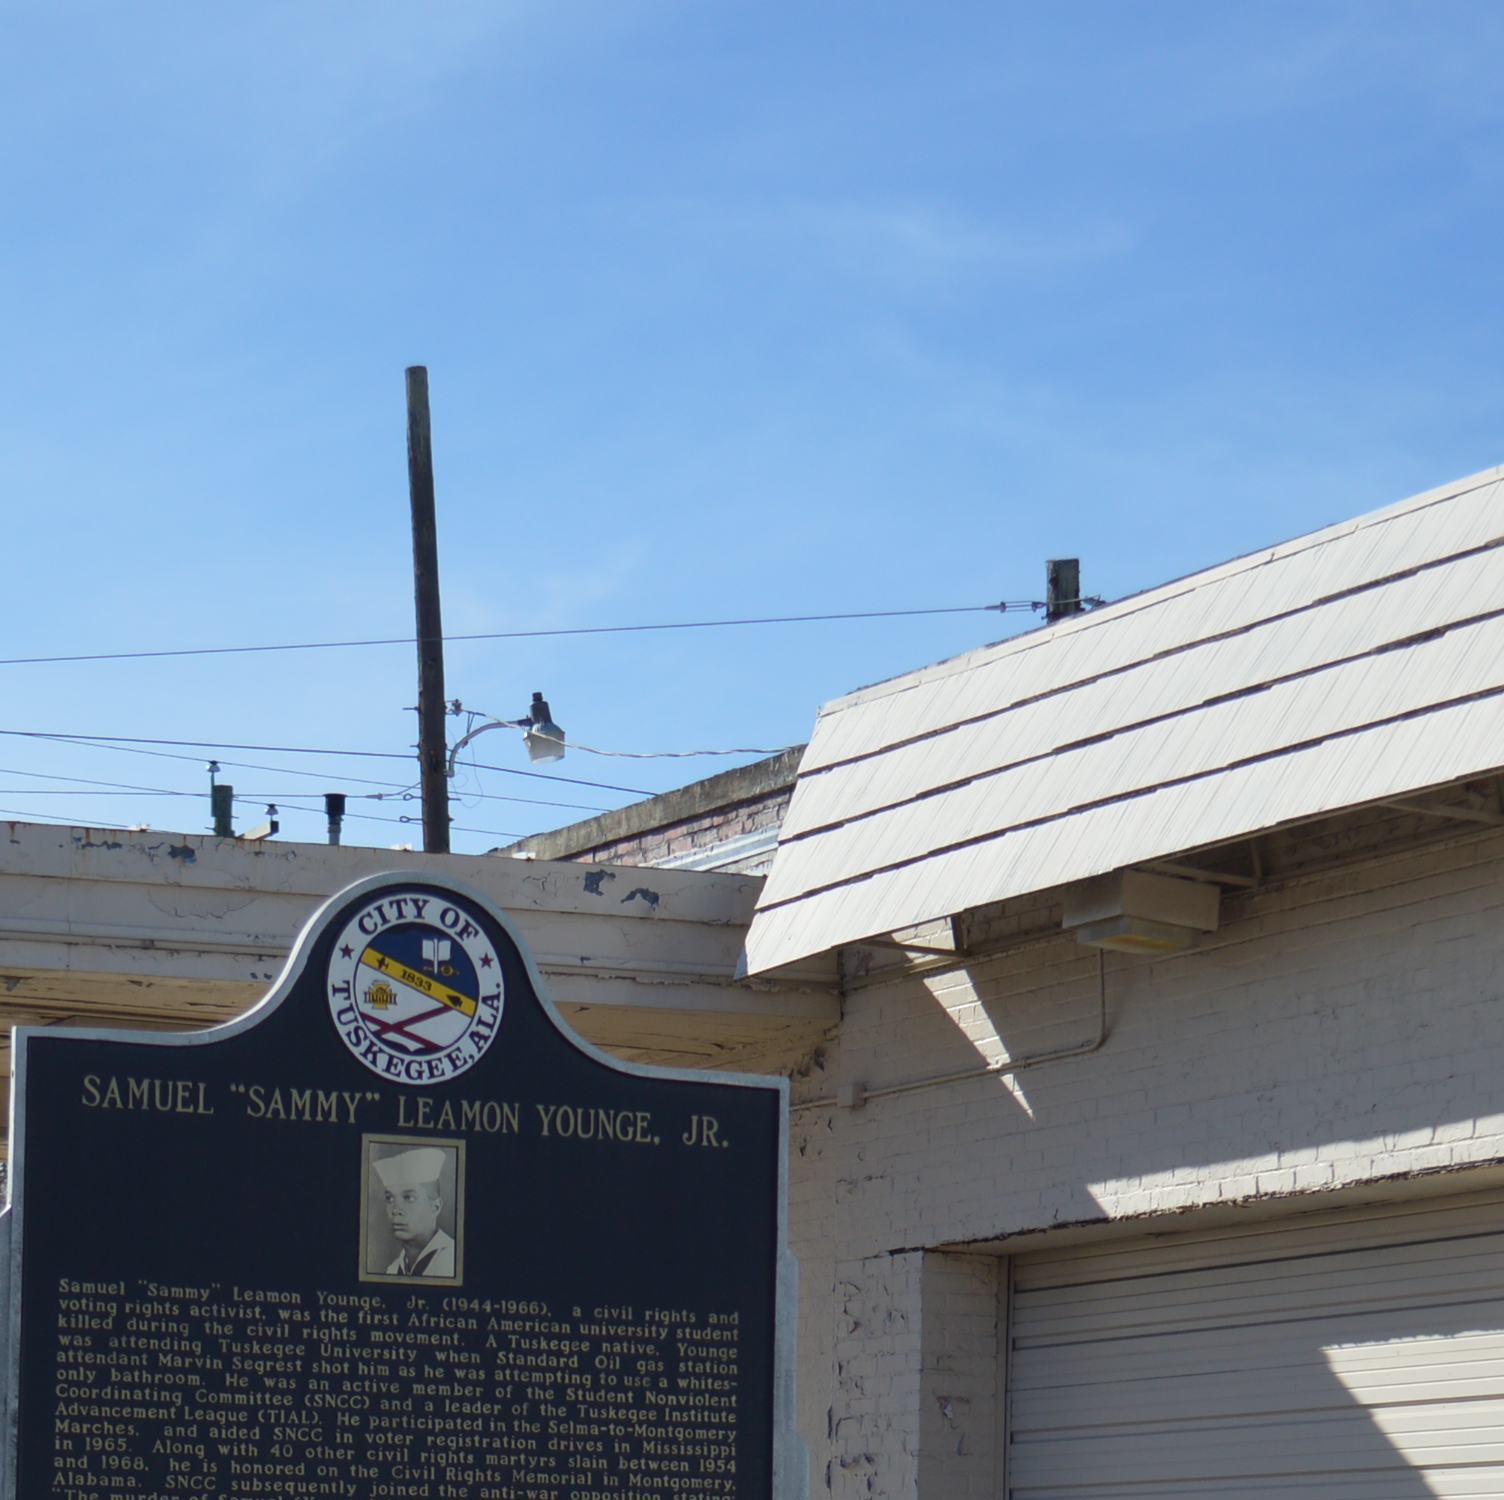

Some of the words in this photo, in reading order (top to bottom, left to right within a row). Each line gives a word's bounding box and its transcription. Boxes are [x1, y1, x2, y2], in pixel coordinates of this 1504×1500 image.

[358, 897, 430, 936] CITY
[439, 907, 480, 942] OF
[401, 969, 432, 992] 1833
[332, 980, 476, 1081] TUSKEGEE,
[468, 982, 501, 1053] ALA.
[82, 1075, 214, 1114] SAMUEL
[230, 1084, 380, 1124] "SAMMY"
[397, 1096, 519, 1134] LEAMON
[536, 1105, 660, 1145] YOUNGE,
[682, 1115, 729, 1148] JR.
[58, 1278, 125, 1295] Samuel
[138, 1279, 220, 1302] "Sammy"
[233, 1286, 301, 1304] Leamon
[317, 1290, 385, 1310] Younge,
[406, 1295, 429, 1309] Jr.
[442, 1297, 551, 1317] (1944-1966),
[572, 1306, 581, 1317] a
[593, 1305, 632, 1320] civil
[645, 1307, 696, 1324] rights
[708, 1311, 738, 1325] and
[58, 1297, 117, 1316] voting
[125, 1299, 179, 1318] rights
[190, 1303, 266, 1320] activist,
[277, 1309, 310, 1321] was
[319, 1308, 348, 1323] the
[358, 1309, 398, 1325] first
[407, 1312, 477, 1329] African
[487, 1316, 570, 1334] American
[579, 1321, 668, 1340] university
[676, 1326, 738, 1341] student
[58, 1313, 113, 1329] killed
[126, 1316, 189, 1337] during
[204, 1321, 233, 1335] the
[246, 1322, 289, 1338] civil
[302, 1325, 356, 1343] rights
[370, 1330, 464, 1346] movement.
[485, 1333, 497, 1348] A
[507, 1334, 590, 1353] Tuskegee
[601, 1340, 659, 1356] native,
[677, 1342, 737, 1360] Younge
[58, 1334, 91, 1346] was
[108, 1335, 201, 1354] attending
[218, 1338, 305, 1358] Tuskegee
[320, 1341, 417, 1362] University
[434, 1349, 480, 1363] when
[496, 1350, 578, 1368] Standard
[594, 1354, 620, 1370] Oil
[636, 1360, 664, 1373] gas
[678, 1358, 737, 1375] station
[55, 1383, 182, 1406] Coordinating
[195, 1388, 293, 1406] Committee
[304, 1393, 370, 1409] (SNCC)
[380, 1397, 412, 1411] and
[424, 1401, 433, 1412] a
[445, 1398, 502, 1415] leader
[511, 1402, 529, 1415] of
[539, 1403, 567, 1417] the
[576, 1404, 657, 1423] Tuskegee
[664, 1407, 736, 1423] Institute
[56, 1366, 96, 1383] only
[111, 1367, 205, 1386] bathroom.
[225, 1372, 248, 1387] He
[263, 1377, 296, 1389] was
[308, 1378, 329, 1391] an
[342, 1378, 399, 1393] active
[412, 1382, 483, 1397] member
[495, 1384, 513, 1398] of
[526, 1384, 554, 1400] the
[566, 1386, 633, 1403] Student
[645, 1390, 737, 1407] Nonviolent
[55, 1401, 176, 1419] Advancement
[184, 1405, 248, 1424] League
[257, 1409, 322, 1425] (TIAL).
[337, 1411, 360, 1426] He
[369, 1414, 482, 1432] participated
[489, 1417, 506, 1432] in
[513, 1419, 540, 1433] the
[548, 1419, 736, 1443] Selma-to-Montgomery
[55, 1418, 139, 1436] Marches,
[164, 1424, 197, 1437] and
[209, 1423, 260, 1440] aided
[273, 1426, 322, 1442] SNCC
[335, 1428, 353, 1444] in
[364, 1431, 413, 1445] voter
[426, 1431, 536, 1450] registration
[548, 1436, 603, 1452] drives
[614, 1438, 630, 1453] in
[642, 1440, 736, 1459] Mississippi
[53, 1471, 141, 1487] Alabama.
[165, 1474, 216, 1490] SNCC
[231, 1477, 356, 1497] subsequently
[369, 1481, 429, 1497] joined
[438, 1484, 468, 1498] the
[480, 1485, 558, 1500] anti-war
[54, 1455, 87, 1469] and
[101, 1455, 149, 1471] 1968,
[169, 1457, 190, 1472] he
[203, 1458, 217, 1473] is
[230, 1460, 305, 1475] honored
[317, 1465, 338, 1477] on
[350, 1464, 378, 1478] the
[391, 1465, 435, 1480] Civil
[445, 1466, 501, 1484] Rights
[512, 1468, 592, 1485] Memorial
[603, 1471, 618, 1486] in
[629, 1472, 736, 1492] Montgomery,
